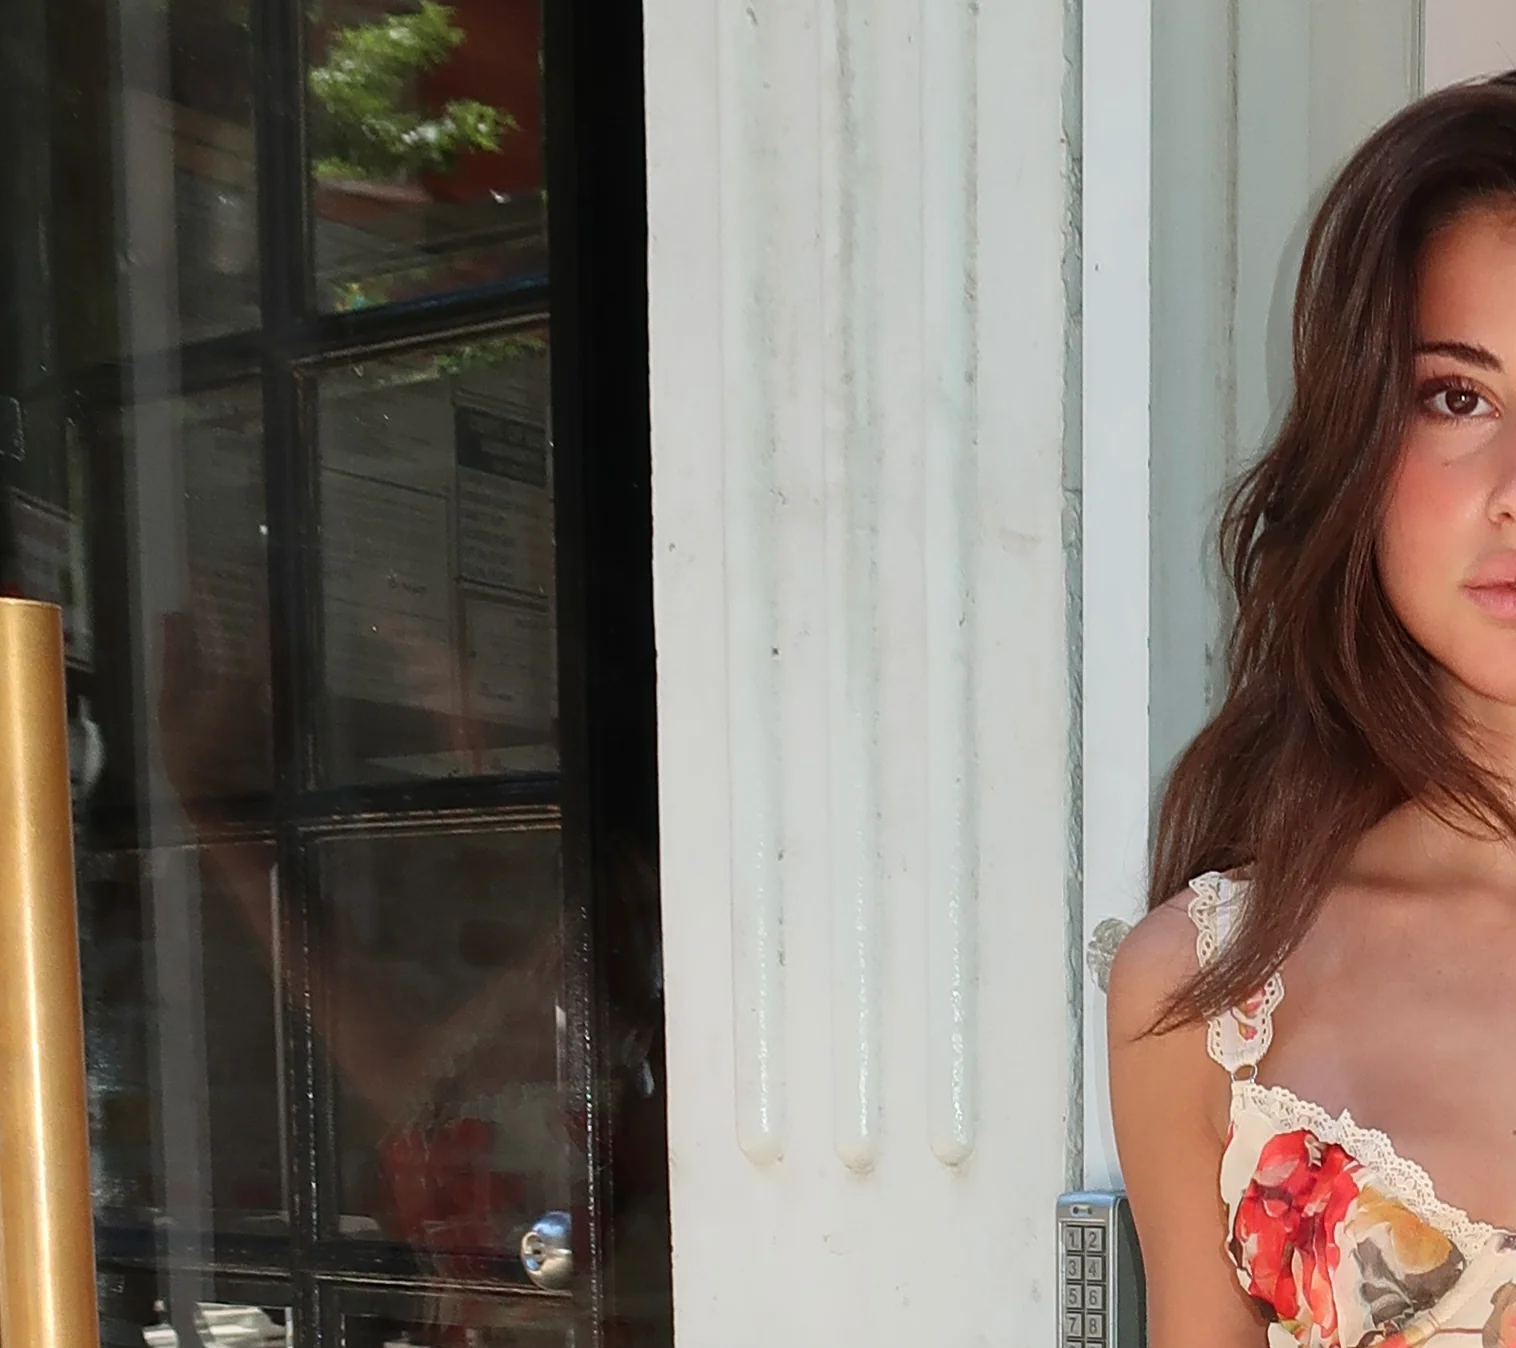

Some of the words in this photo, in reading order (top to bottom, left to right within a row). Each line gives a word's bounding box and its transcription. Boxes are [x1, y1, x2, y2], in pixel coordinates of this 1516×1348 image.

[1068, 1231, 1079, 1248] 1
[1088, 1231, 1097, 1248] 2
[1068, 1260, 1077, 1276] 3
[1088, 1260, 1097, 1277] 4
[1068, 1288, 1077, 1305] 5
[1088, 1289, 1097, 1306] 6
[1068, 1316, 1077, 1333] 7
[1088, 1318, 1098, 1335] 8
